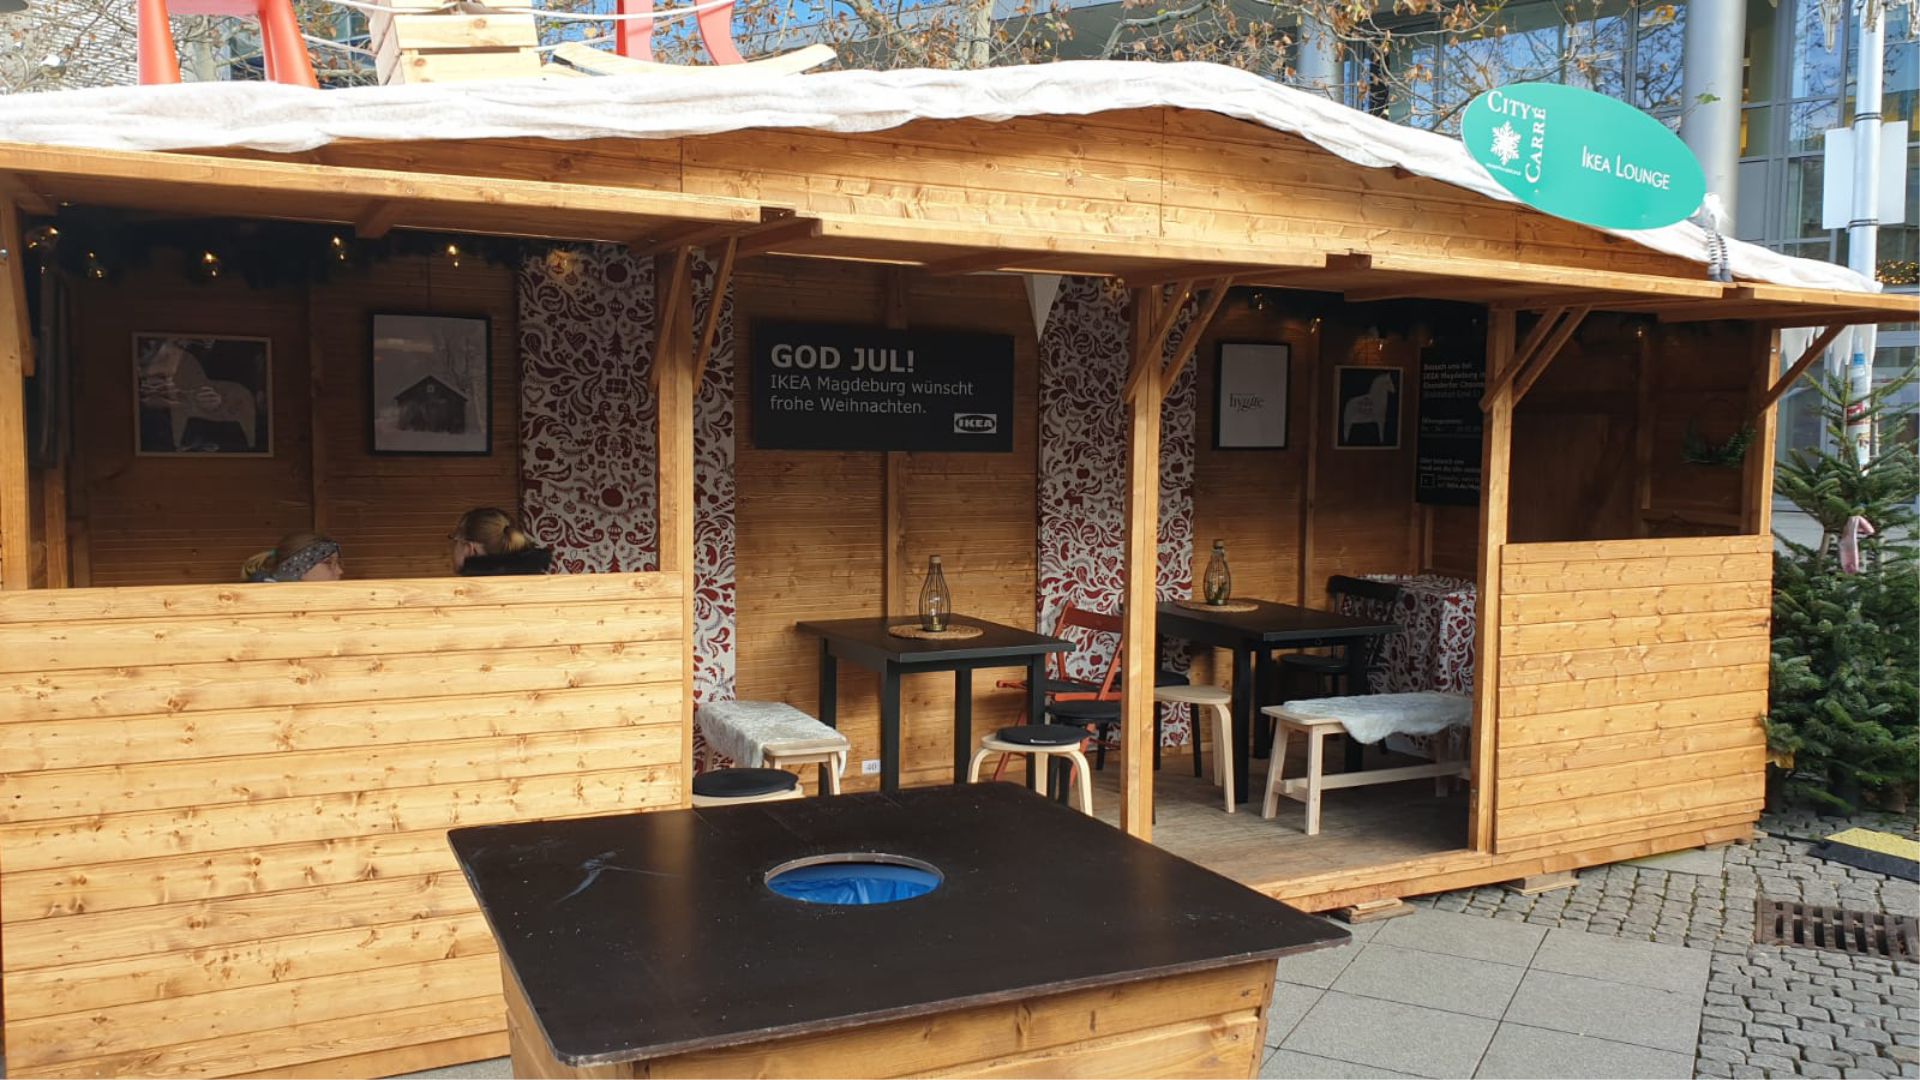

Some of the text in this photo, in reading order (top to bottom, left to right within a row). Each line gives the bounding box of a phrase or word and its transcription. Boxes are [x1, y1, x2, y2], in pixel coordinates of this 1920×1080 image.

[771, 343, 914, 373] GOD JUL!
[770, 374, 974, 397] IKEA Magdeburg wünscht
[770, 395, 927, 414] frohe Weihnachten.
[957, 418, 993, 428] IKEA
